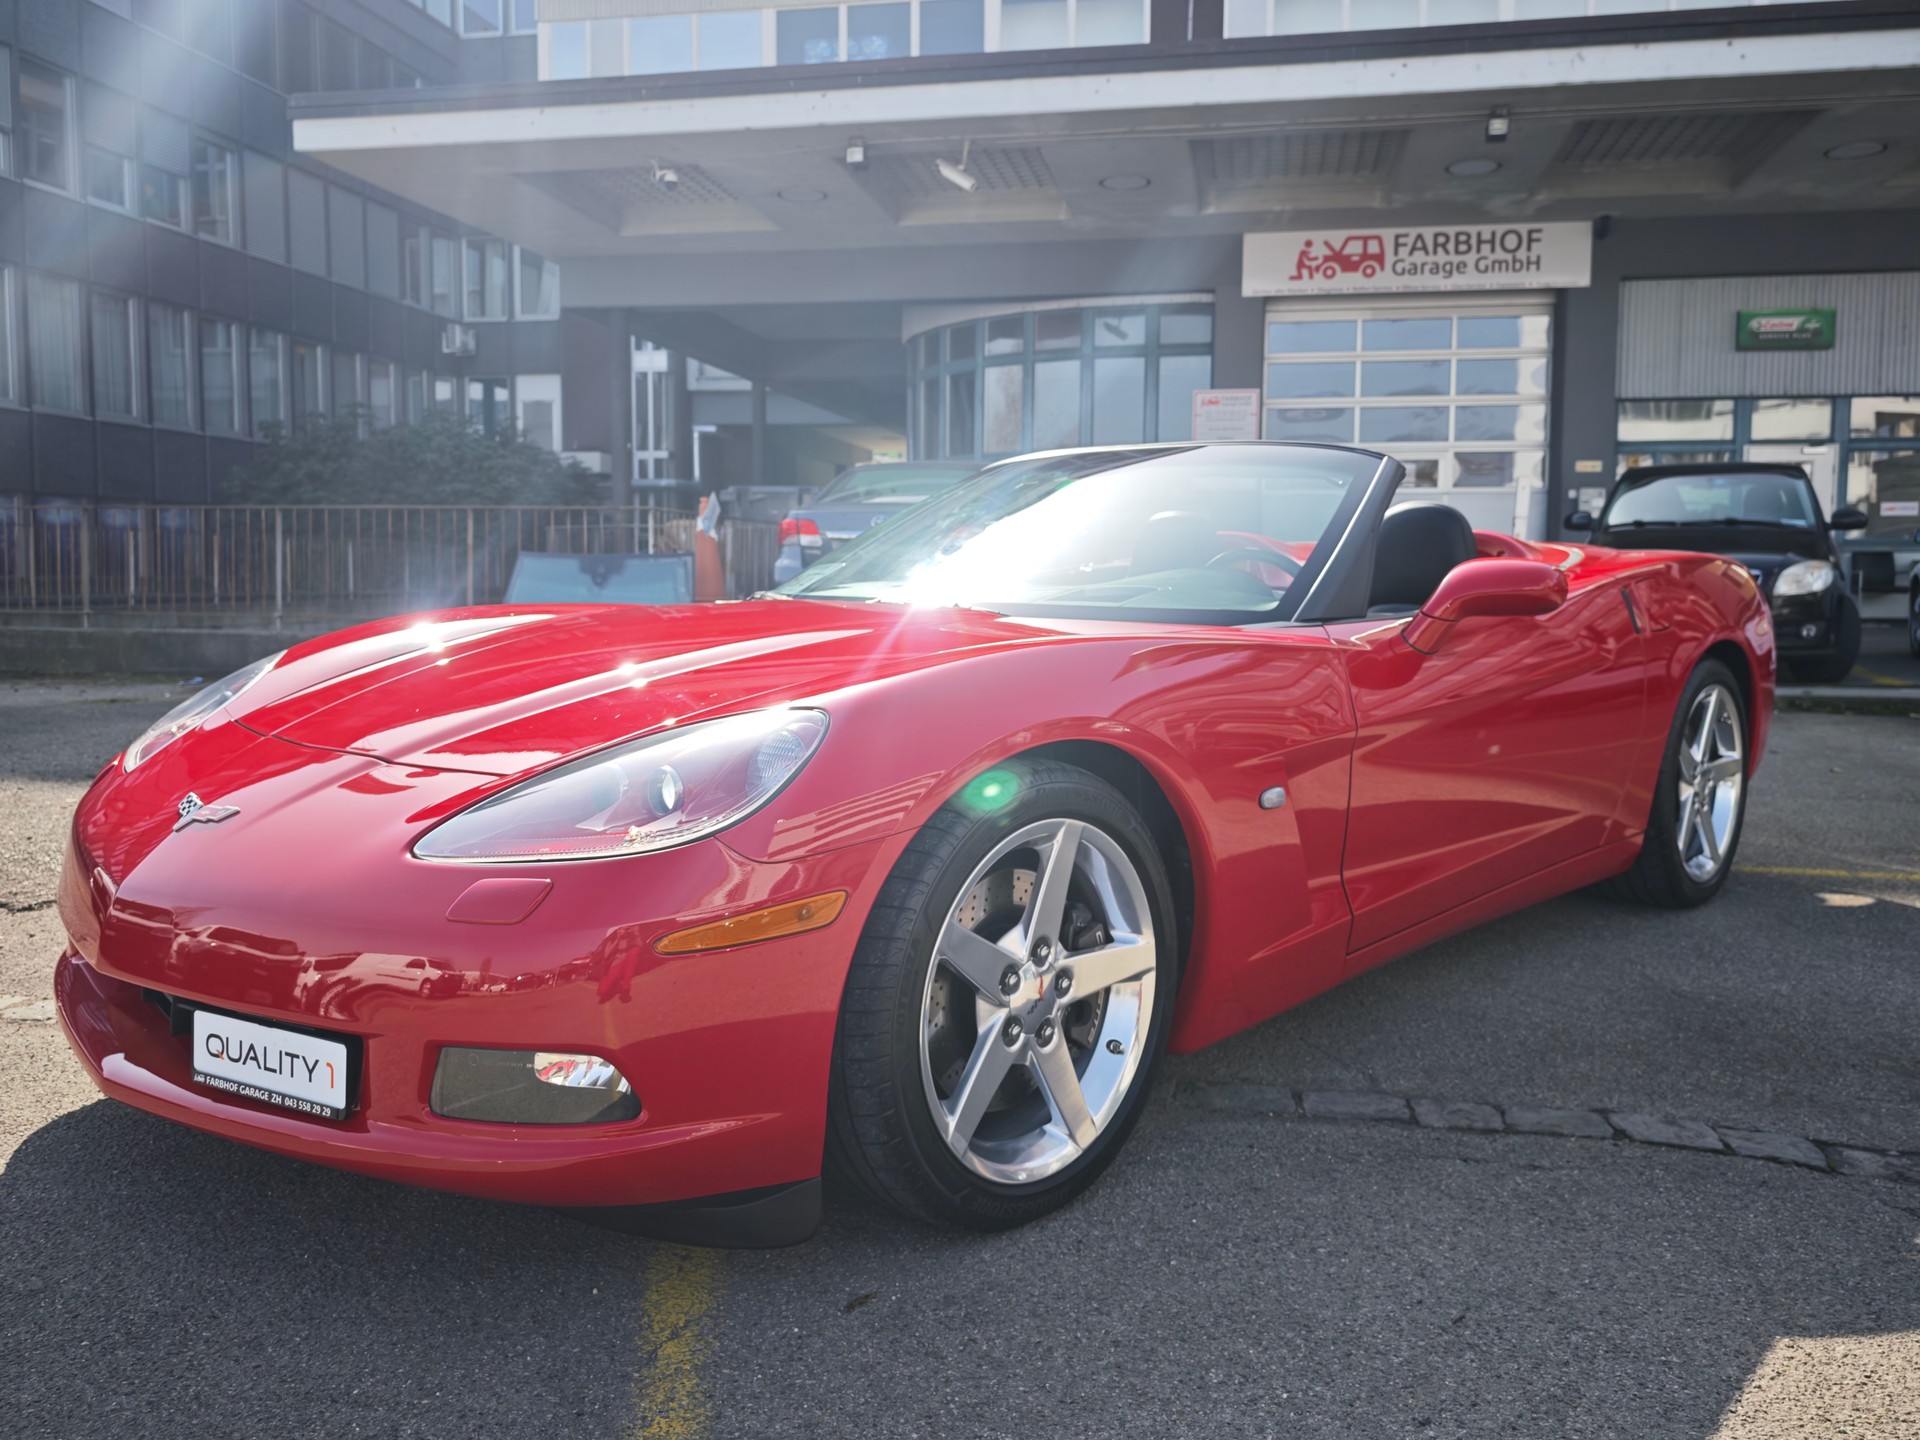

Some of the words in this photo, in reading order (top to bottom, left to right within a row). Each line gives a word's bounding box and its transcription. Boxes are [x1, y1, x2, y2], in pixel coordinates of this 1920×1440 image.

[1393, 228, 1543, 257] FARBHOF
[1391, 258, 1468, 279] Garage
[1474, 254, 1541, 274] GmbH
[206, 1033, 319, 1083] QUALITY
[206, 1076, 239, 1092] FARBHOF
[239, 1085, 269, 1101] GARAGE
[271, 1093, 282, 1104] ZH
[284, 1097, 297, 1109] 043
[298, 1101, 311, 1112] 558
[312, 1105, 321, 1115] 29
[321, 1106, 331, 1117] 29
